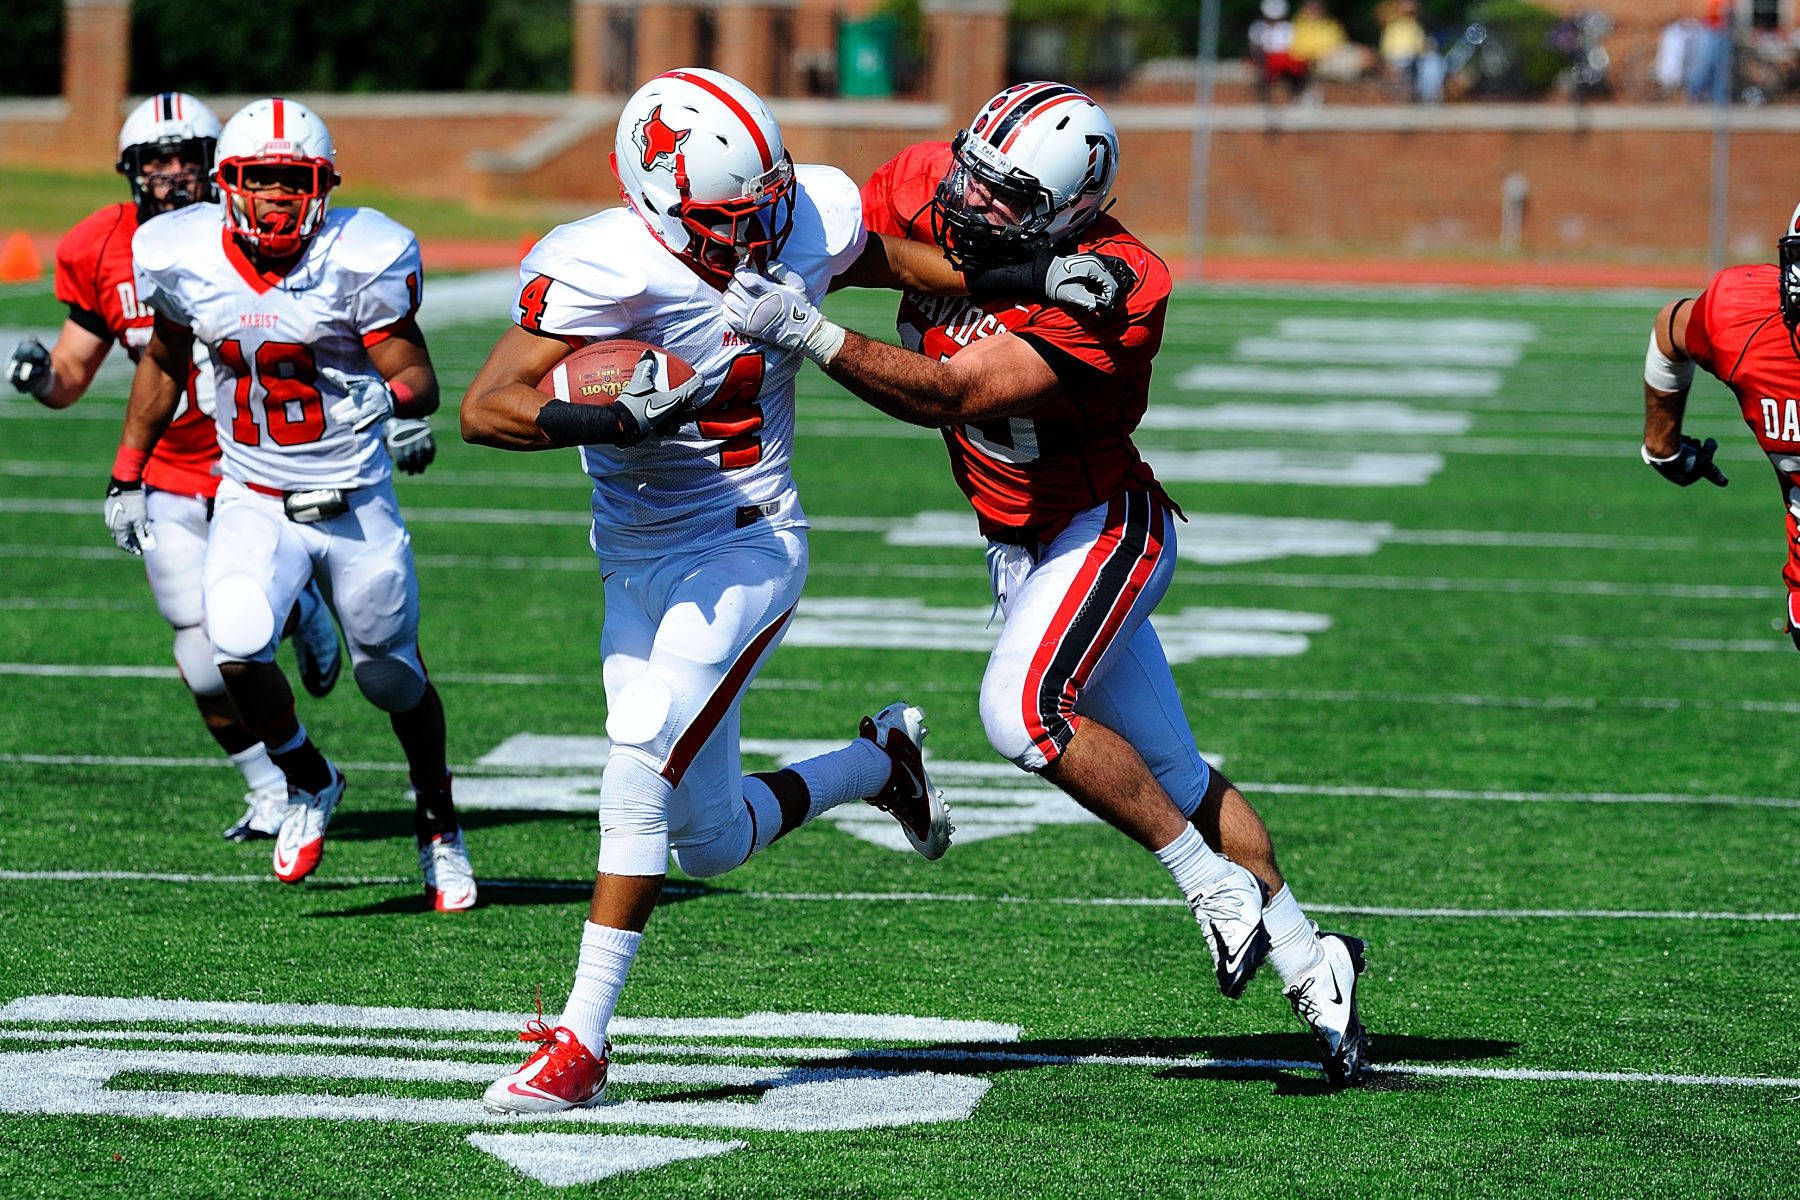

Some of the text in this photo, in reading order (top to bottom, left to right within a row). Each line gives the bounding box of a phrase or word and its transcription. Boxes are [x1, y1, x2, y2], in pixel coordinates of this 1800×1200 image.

[240, 312, 279, 329] MARIST
[518, 274, 554, 333] 4
[219, 339, 327, 447] 18
[697, 351, 766, 471] 4
[1760, 398, 1800, 442] DA
